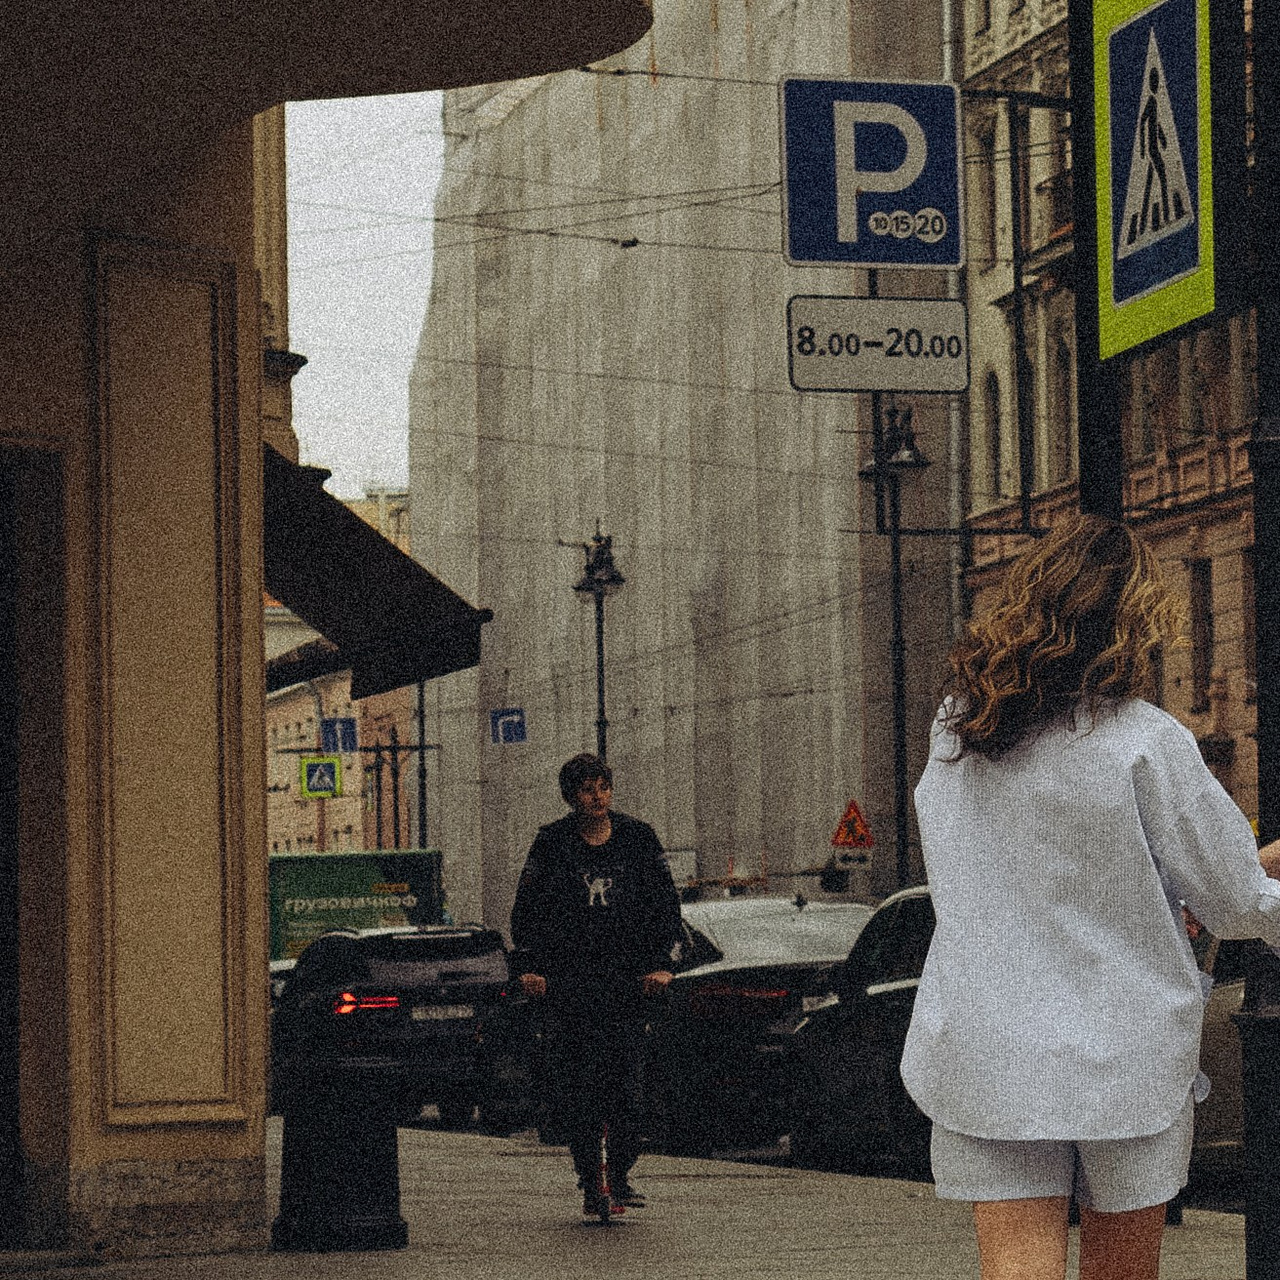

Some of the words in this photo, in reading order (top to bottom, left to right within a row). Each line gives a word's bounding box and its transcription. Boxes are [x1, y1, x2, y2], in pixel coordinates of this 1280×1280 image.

[833, 101, 927, 243] P
[893, 216, 911, 234] 15
[917, 214, 944, 235] 20
